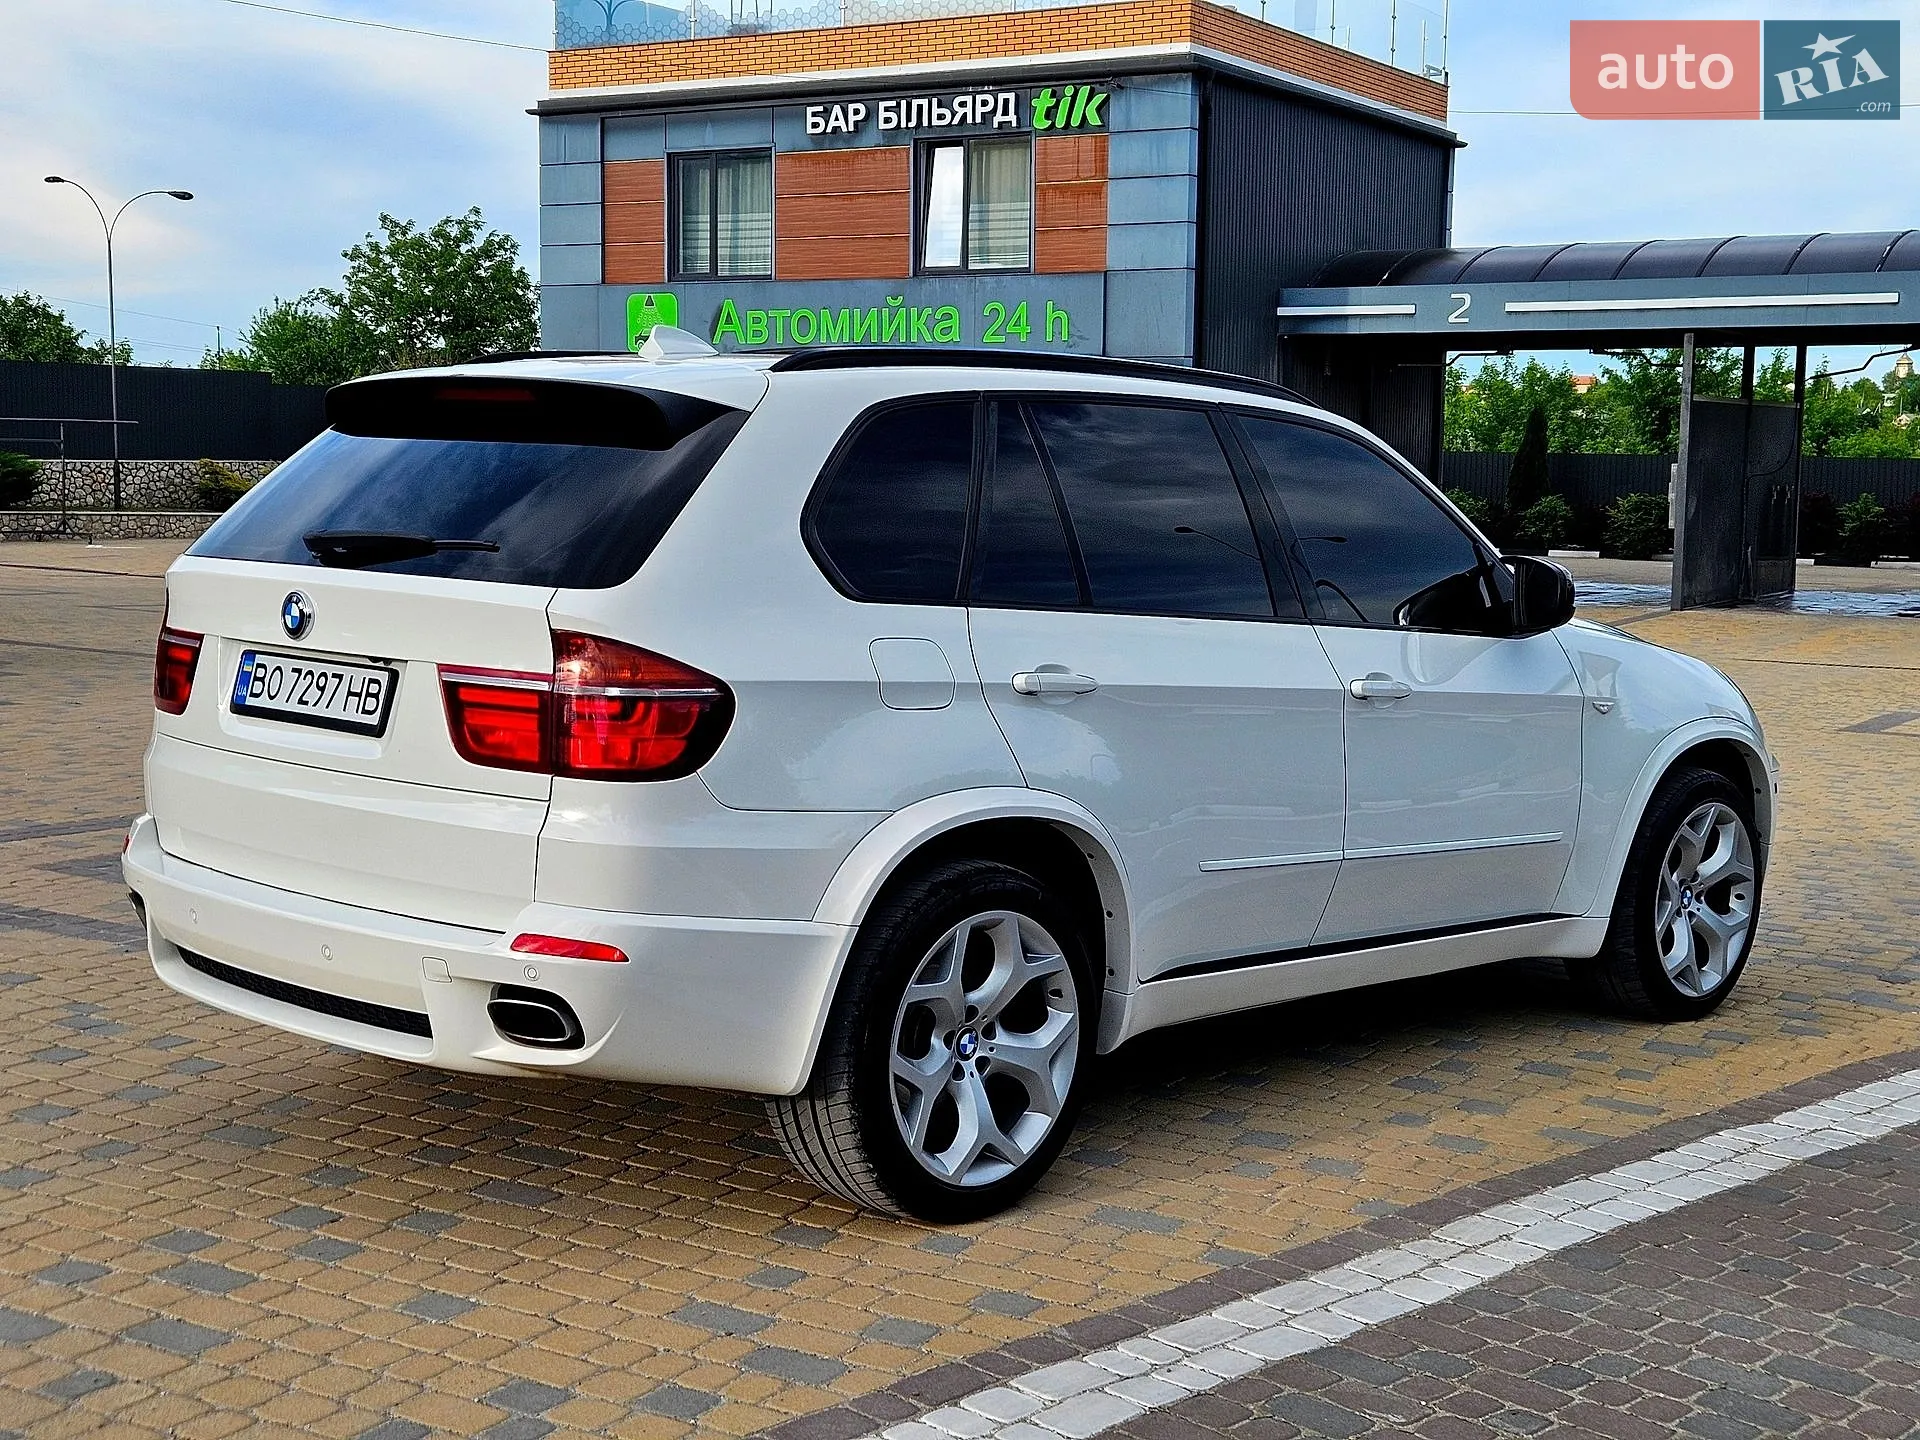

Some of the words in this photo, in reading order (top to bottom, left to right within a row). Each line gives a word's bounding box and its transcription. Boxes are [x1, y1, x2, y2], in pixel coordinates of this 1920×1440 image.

[805, 103, 867, 135] БАР
[878, 92, 1017, 130] БІЛЬЯРД
[1031, 85, 1109, 130] tik
[713, 296, 961, 344] Автомийка
[982, 301, 1032, 343] 24
[1046, 301, 1070, 341] h
[1448, 293, 1471, 323] 2
[249, 662, 284, 701] BO
[285, 667, 345, 710] 7297
[342, 674, 383, 716] HB
